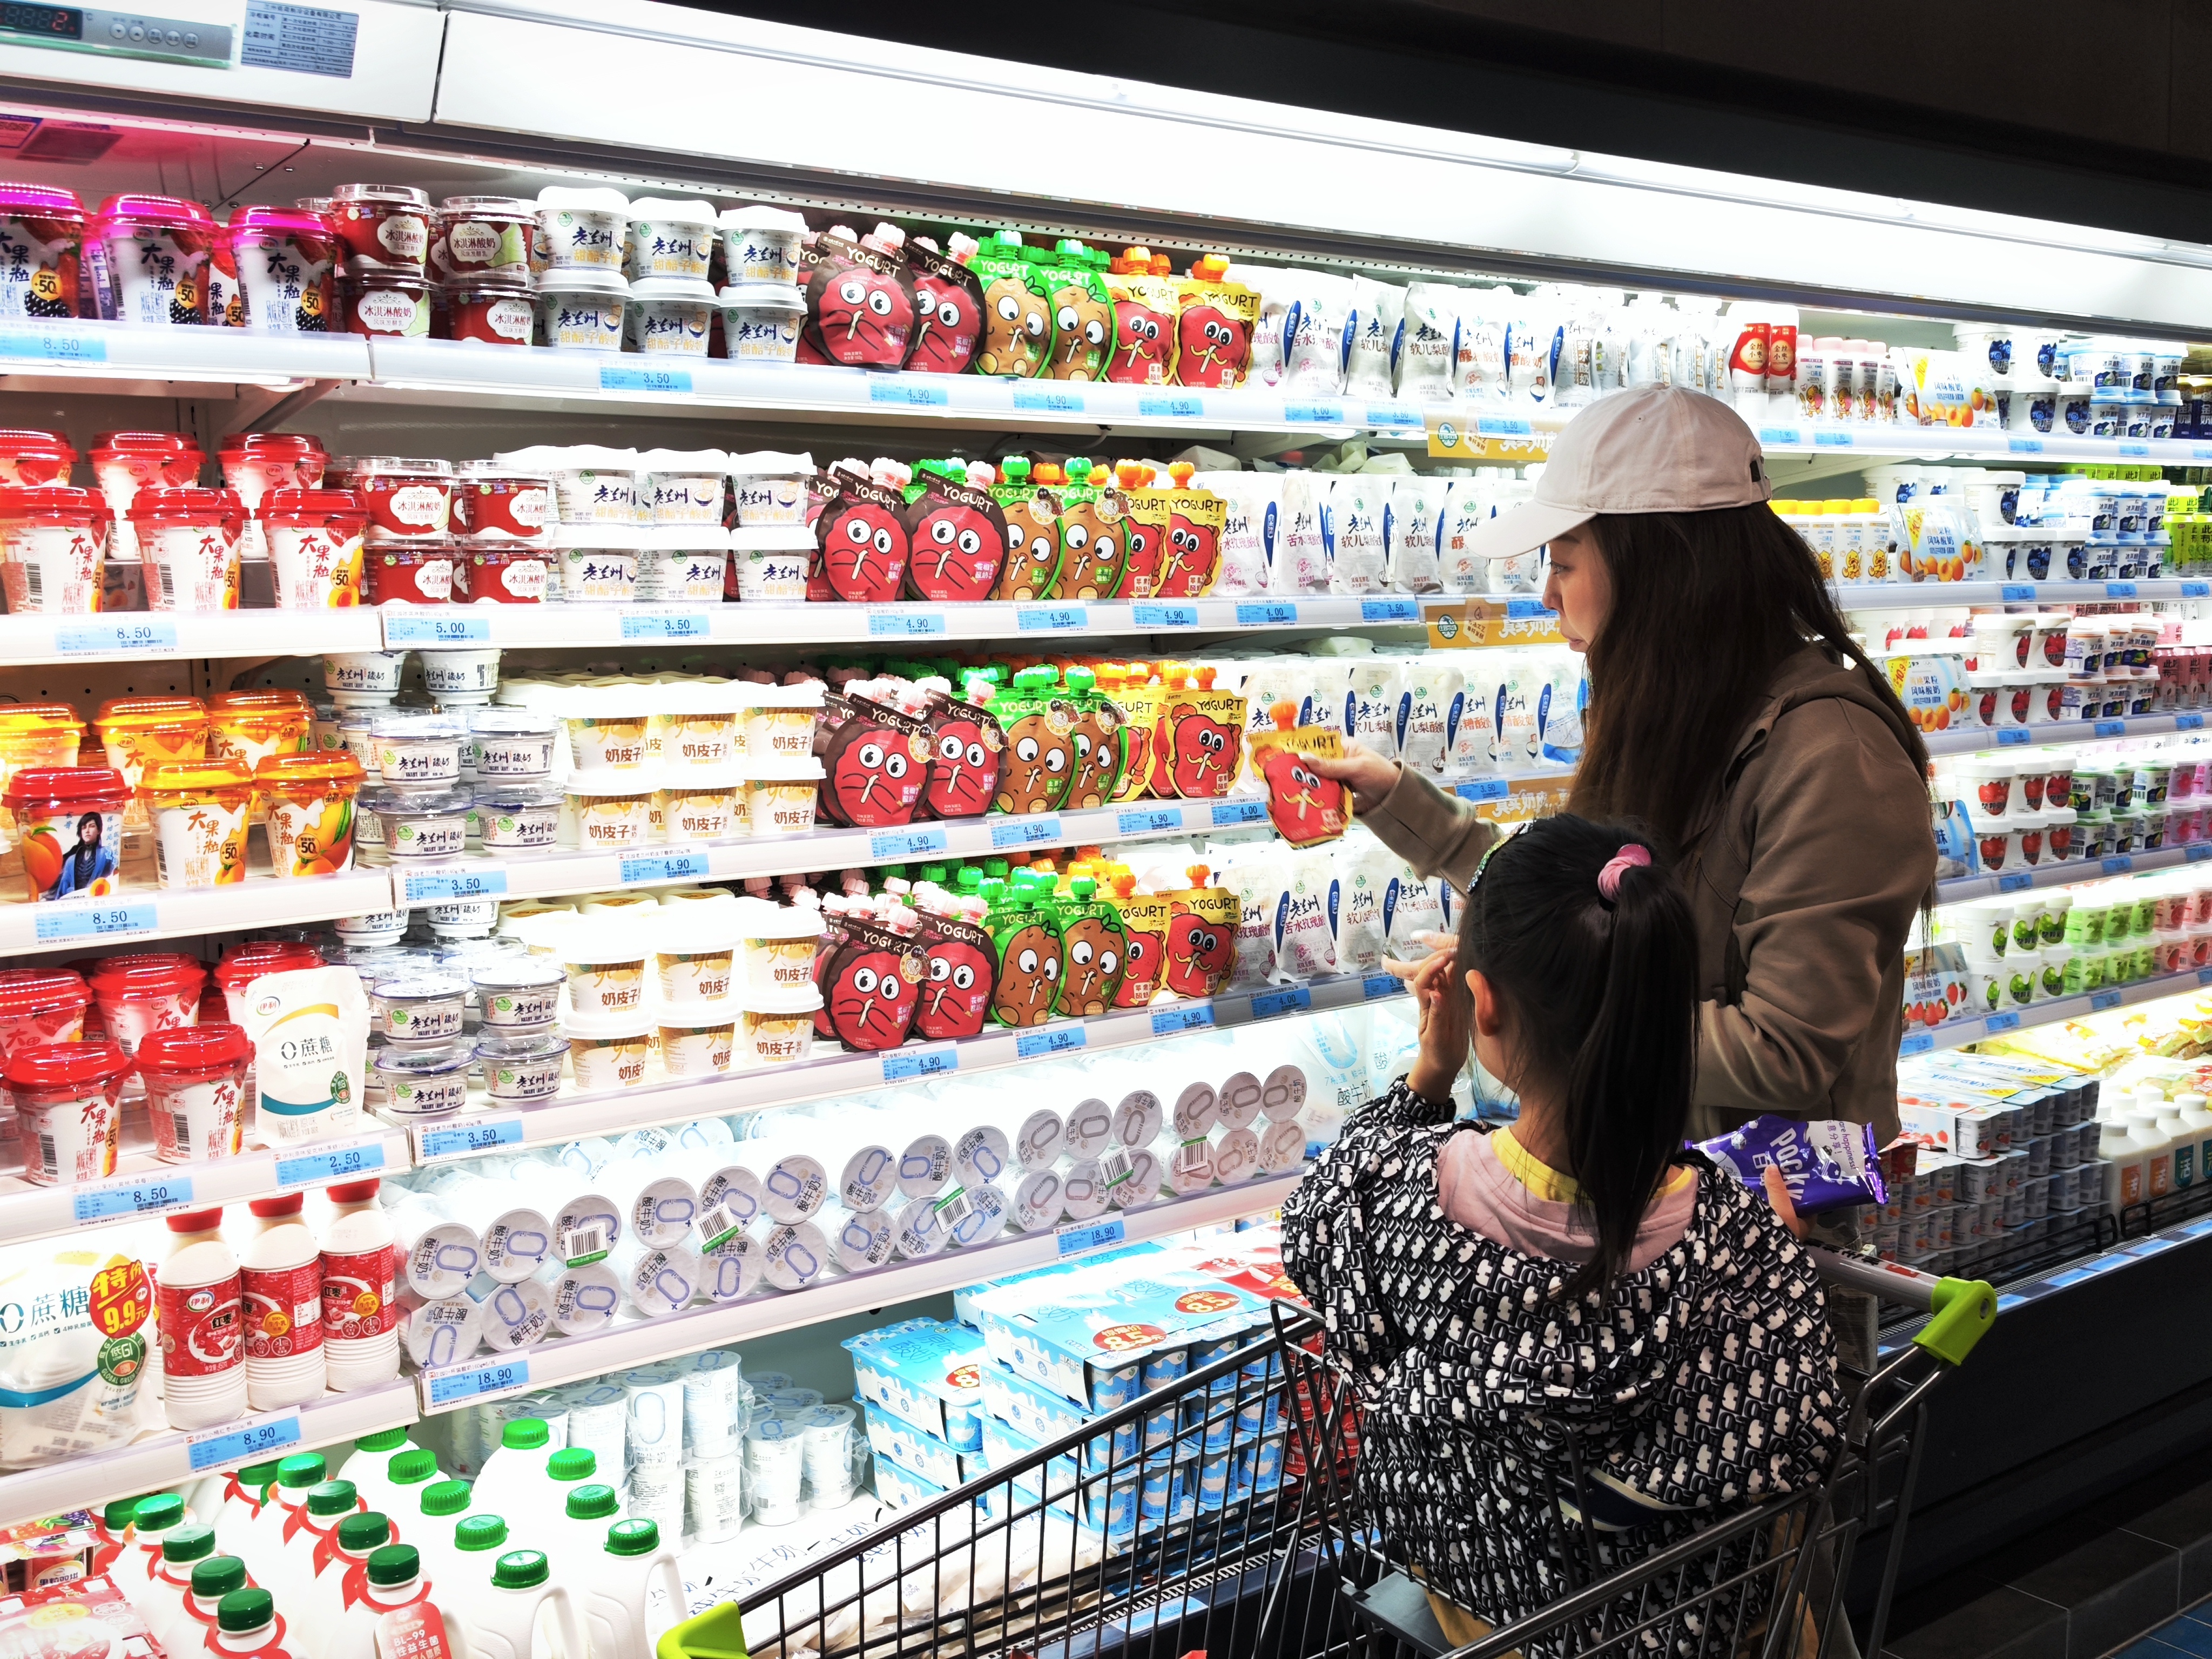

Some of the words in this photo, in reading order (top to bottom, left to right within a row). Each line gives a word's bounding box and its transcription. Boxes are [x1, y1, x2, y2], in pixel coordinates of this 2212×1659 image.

[386, 230, 424, 244] 冰淇淋酸奶
[454, 237, 496, 248] 冰淇淋酸奶
[572, 227, 612, 245] 老兰州
[652, 237, 691, 256] 老兰州
[744, 246, 782, 263] 老兰州
[847, 246, 900, 277] YOGURT
[141, 243, 175, 291] 大果粒
[925, 256, 972, 287] YOGURT
[981, 259, 1029, 275] YOGURT
[267, 253, 300, 299] 大果粒
[1042, 269, 1091, 285] YOGURT
[1205, 293, 1258, 308] YOGURT
[365, 305, 412, 318] 冰淇淋酸奶
[558, 309, 598, 328] 老兰州
[495, 314, 531, 325] 冰淇淋酸奶
[645, 316, 683, 335] 老兰州
[739, 322, 777, 340] 老兰州
[43, 338, 79, 351] 8.50
[644, 373, 670, 384] 3.50
[907, 389, 929, 400] 4.90
[1046, 395, 1066, 406] 4.90
[1170, 401, 1189, 411] 4.90
[1312, 407, 1328, 415] 4.00
[654, 488, 688, 505] 老兰州
[740, 489, 772, 505] 老兰州
[855, 482, 896, 512] YOGURT
[943, 484, 993, 512] YOGURT
[398, 502, 441, 511] 冰淇淋酸奶
[1172, 500, 1223, 512] YOGURT
[70, 535, 93, 581] 大果粒
[199, 535, 224, 579] 大果粒
[300, 535, 329, 578] 大果粒
[509, 575, 545, 584] 冰淇淋酸奶
[583, 564, 623, 581] 老兰州
[763, 564, 799, 582] 老兰州
[1266, 607, 1284, 616] 4.00
[1387, 603, 1404, 612] 3.50
[1050, 611, 1070, 622] 4.90
[1165, 611, 1183, 620] 4.90
[436, 622, 464, 633] 5.00
[664, 619, 690, 630] 3.50
[906, 618, 928, 629] 4.90
[117, 626, 151, 639] 8.50
[1197, 699, 1244, 711] YOGURT
[872, 707, 919, 734] YOGURT
[683, 744, 721, 758] 奶皮子
[773, 737, 808, 751] 奶皮子
[484, 751, 508, 765] 老兰州
[513, 753, 531, 763] 酸奶
[605, 748, 642, 763] 奶皮子
[399, 757, 428, 770] 老兰州
[433, 758, 450, 767] 酸奶
[1480, 784, 1496, 794] 3.50
[1240, 806, 1257, 815] 4.00
[268, 802, 294, 845] 大果粒
[683, 817, 721, 831] 奶皮子
[774, 812, 810, 825] 奶皮子
[1149, 814, 1168, 824] 4.90
[188, 811, 220, 855] 大果粒
[589, 825, 630, 839] 奶皮子
[1023, 824, 1043, 834] 4.90
[907, 836, 928, 847] 4.90
[664, 859, 690, 871] 4.90
[451, 878, 480, 890] 3.50
[1057, 904, 1105, 916] YOGURT
[1190, 899, 1238, 910] YOGURT
[93, 911, 127, 925] 8.50
[1002, 911, 1045, 923] YOGURT
[936, 920, 983, 945] YOGURT
[864, 930, 911, 954] YOGURT
[774, 967, 809, 981] 奶皮子
[602, 989, 638, 1006] 奶皮子
[1279, 994, 1296, 1005] 4.00
[259, 1000, 278, 1011] 伊利
[410, 1014, 440, 1030] 老兰州
[1182, 1012, 1201, 1022] 4.90
[1048, 1033, 1068, 1044] 4.90
[757, 1041, 794, 1055] 奶皮子
[919, 1056, 940, 1068] 4.90
[415, 1088, 444, 1102] 老兰州
[1338, 1080, 1371, 1106] 酸牛奶
[213, 1084, 235, 1125] 大果粒
[81, 1102, 107, 1145] 大果粒
[468, 1129, 496, 1143] 3.50
[1842, 1134, 1857, 1170] happiness!
[329, 1152, 360, 1168] 2.50
[933, 1150, 946, 1182] 酸牛奶
[1770, 1127, 1811, 1201] POCKY
[133, 1187, 167, 1203] 8.50
[797, 1181, 821, 1212] 酸牛奶
[846, 1182, 872, 1204] 酸牛奶
[639, 1197, 653, 1231] 酸牛奶
[1091, 1226, 1114, 1240] 18.90
[768, 1227, 797, 1256] 酸牛奶
[867, 1232, 891, 1263] 酸牛奶
[900, 1229, 926, 1253] 酸牛奶
[638, 1252, 667, 1284] 酸牛奶
[92, 1261, 142, 1298] 特价
[191, 1297, 210, 1306] 伊利
[558, 1280, 576, 1316] 酸牛奶
[1185, 1298, 1226, 1313] 8.5
[212, 1312, 232, 1328] 红枣
[510, 1316, 543, 1347] 酸牛奶
[1103, 1331, 1154, 1351] 8.5
[477, 1368, 511, 1385] 18.90
[244, 1427, 275, 1445] 8.90
[394, 1629, 425, 1647] BL-99
